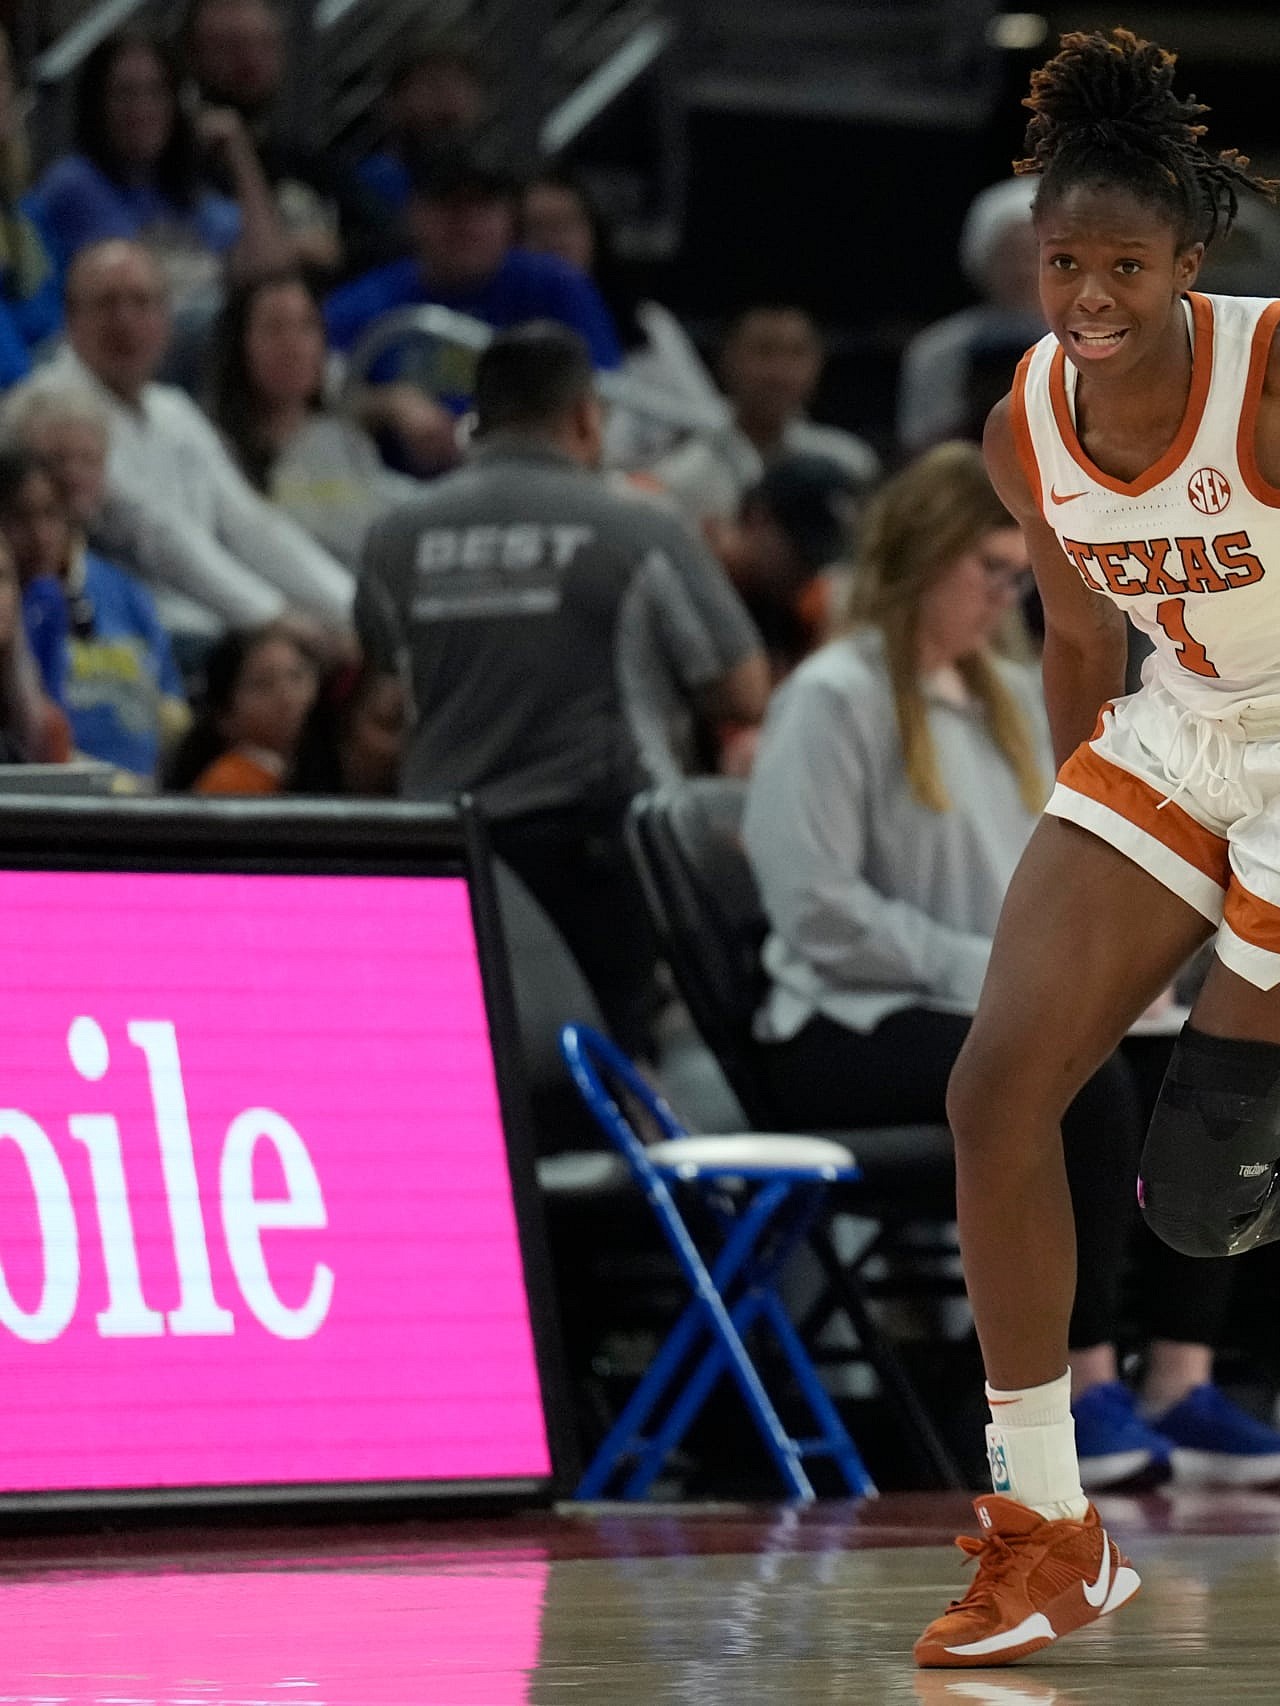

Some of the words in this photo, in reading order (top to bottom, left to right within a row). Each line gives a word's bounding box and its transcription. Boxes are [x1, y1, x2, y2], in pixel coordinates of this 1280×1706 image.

[1188, 467, 1231, 515] SEC
[1062, 530, 1266, 596] TEXAS
[1156, 597, 1221, 679] 1
